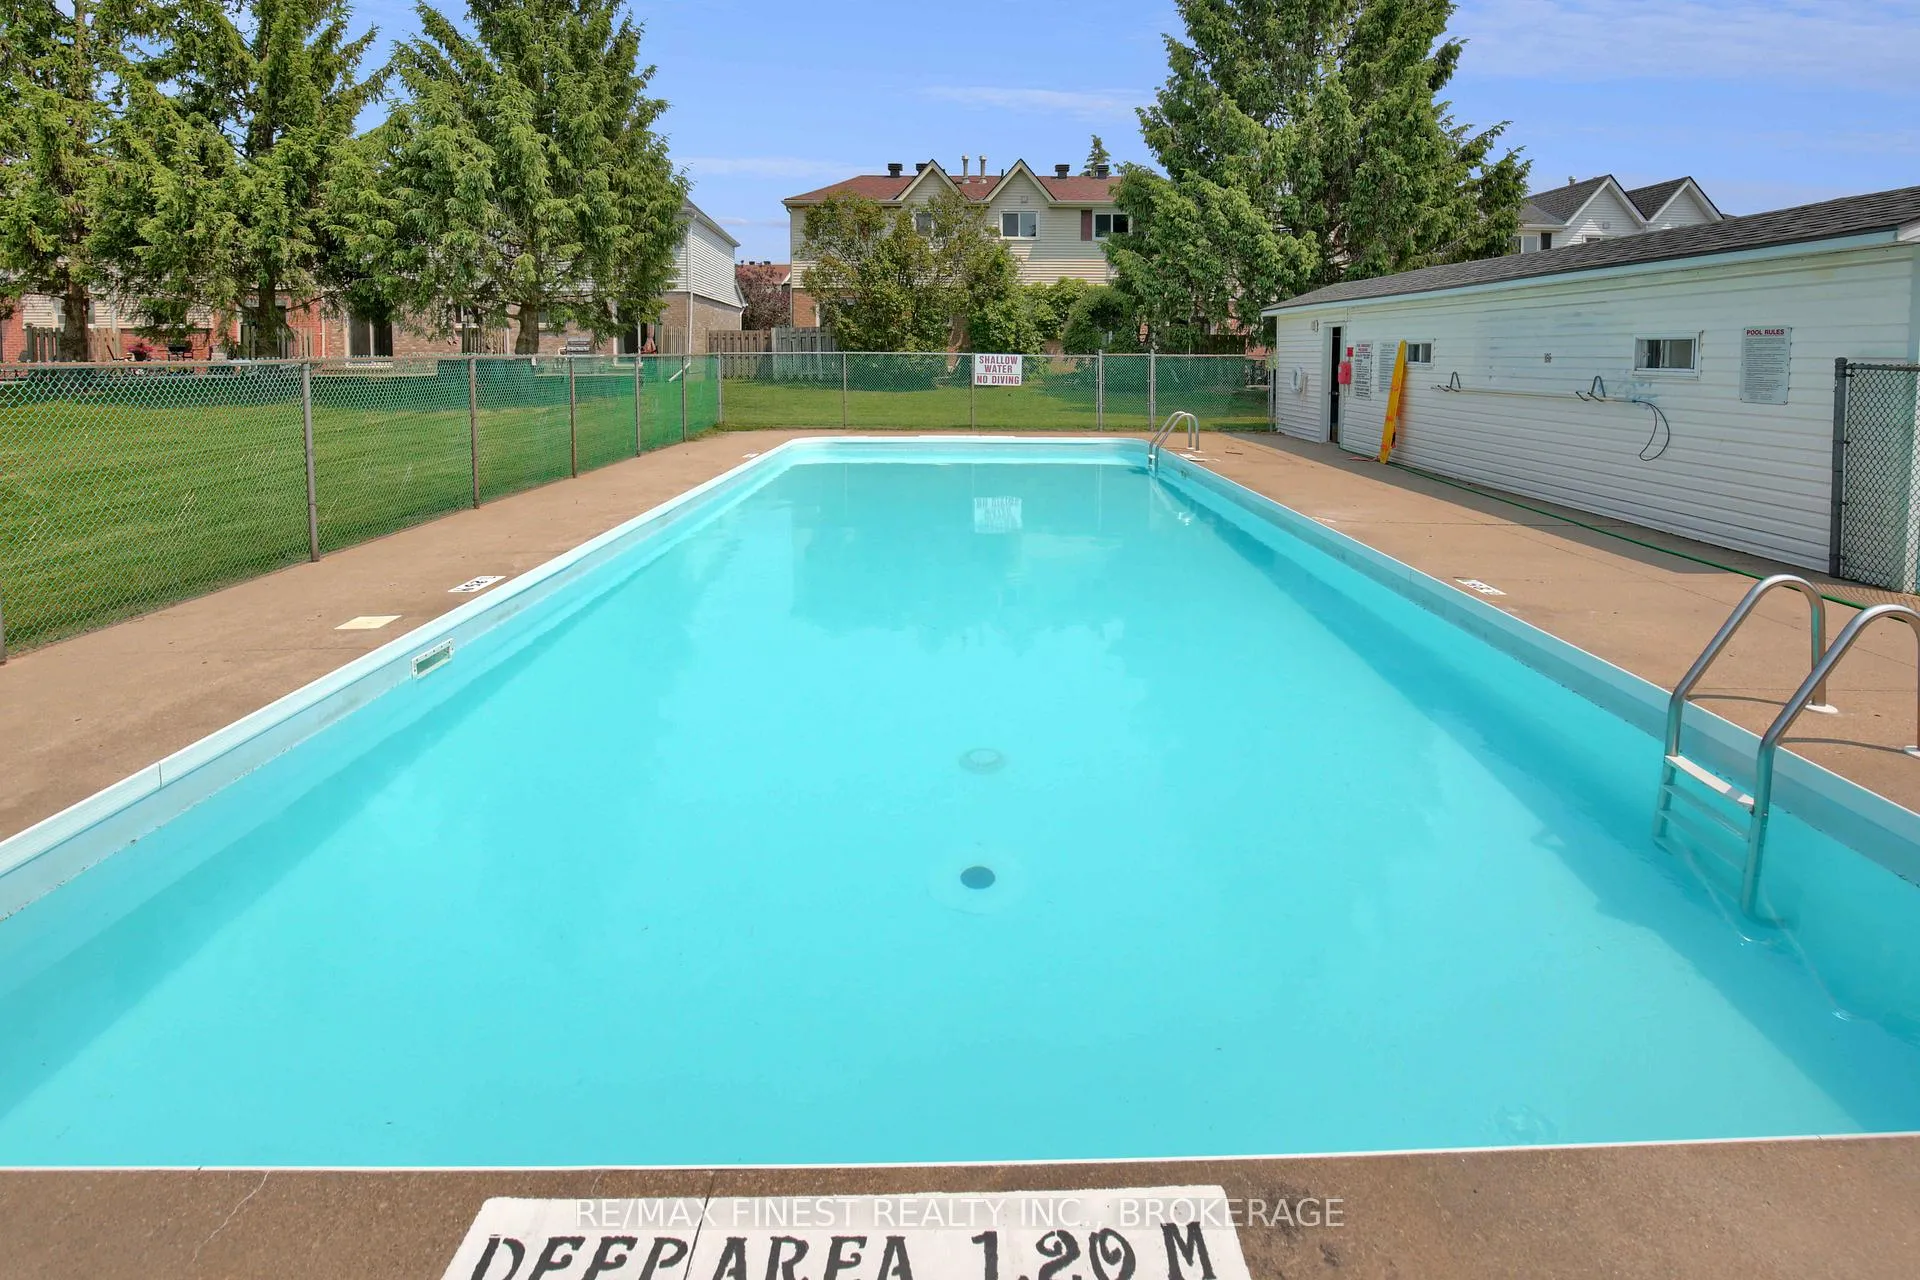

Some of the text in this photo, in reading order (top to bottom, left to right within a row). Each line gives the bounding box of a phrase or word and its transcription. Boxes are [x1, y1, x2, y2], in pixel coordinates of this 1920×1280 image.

[1764, 328, 1785, 336] RULES
[979, 356, 1017, 364] SHALLOW
[985, 365, 1012, 373] WATER
[992, 376, 1019, 384] DIVING
[711, 1235, 913, 1280] AREA
[1160, 1221, 1216, 1280] M
